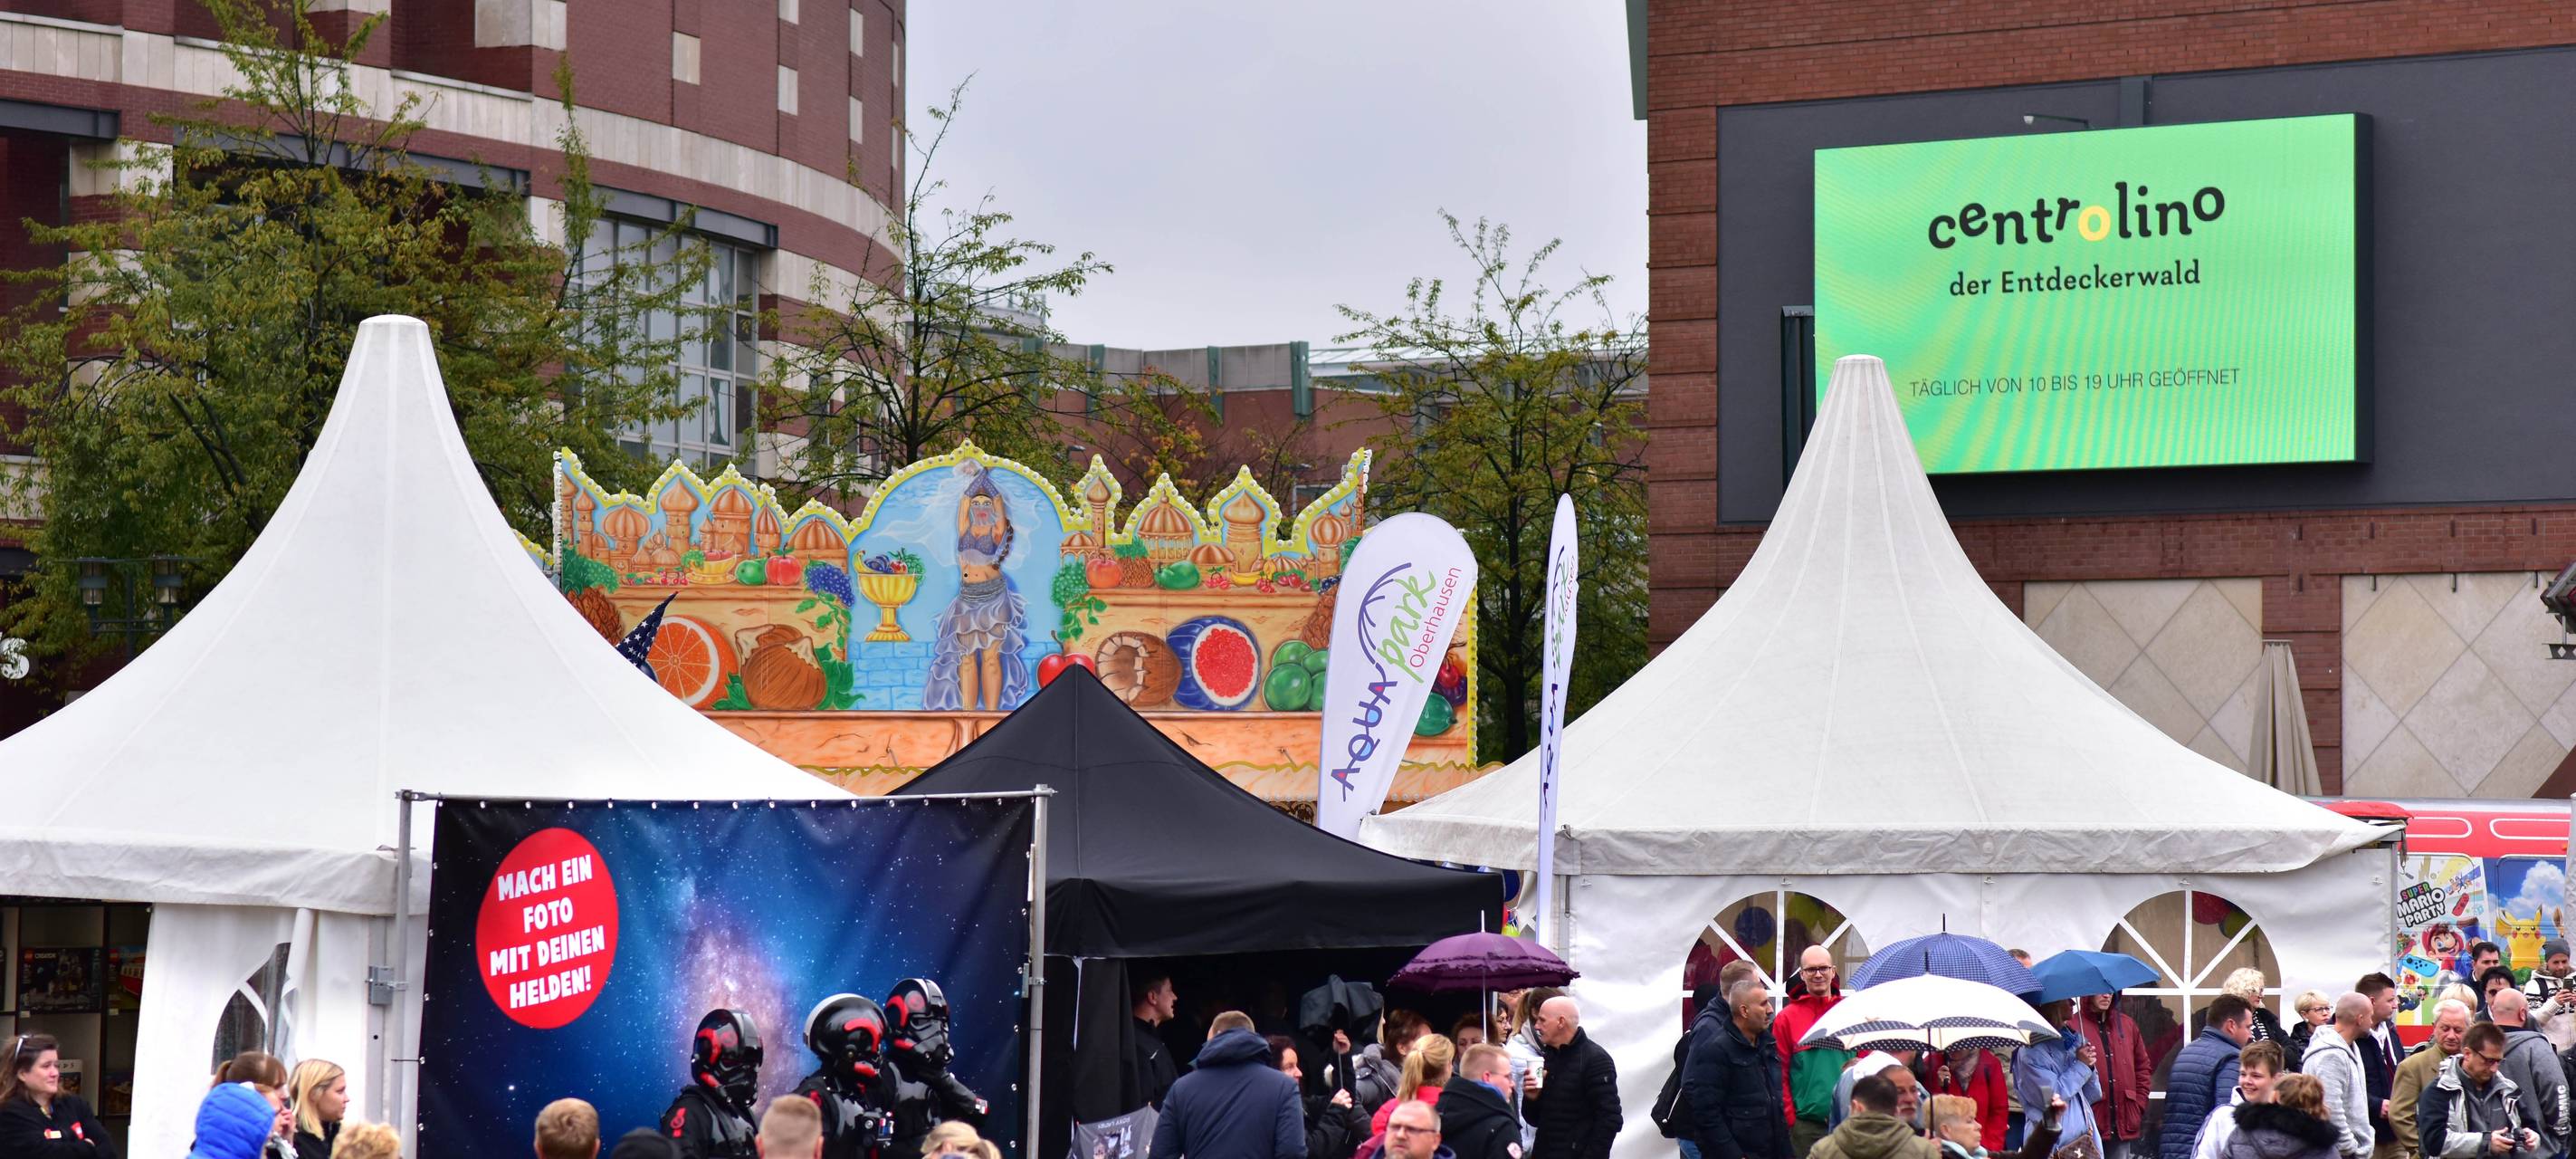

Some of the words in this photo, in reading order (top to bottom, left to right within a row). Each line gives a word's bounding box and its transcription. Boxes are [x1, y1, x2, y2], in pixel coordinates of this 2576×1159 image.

[1929, 181, 2225, 249] centrolino
[1950, 271, 1991, 296] der
[2001, 259, 2200, 293] Entdeckerwald
[1910, 376, 1981, 397] TÄGLICH
[1987, 376, 2023, 394] VON
[2028, 375, 2046, 393] 10
[2051, 374, 2078, 391] BIS
[2084, 373, 2103, 390] 19
[2107, 372, 2144, 390] UHR
[2149, 368, 2240, 388] GEÖFFNET
[1377, 570, 1436, 684] park
[1409, 566, 1463, 668] Oberhausen
[1331, 681, 1398, 800] AQUA
[497, 863, 557, 901] MACH
[561, 854, 593, 886] EIN
[2400, 882, 2432, 901] SUPER
[523, 896, 574, 934] FOTO
[2397, 887, 2446, 918] MARIO
[2404, 902, 2446, 927] PARTY
[490, 944, 531, 976] MIT
[537, 924, 606, 967] DEINEN
[510, 964, 592, 1009] HELDEN!
